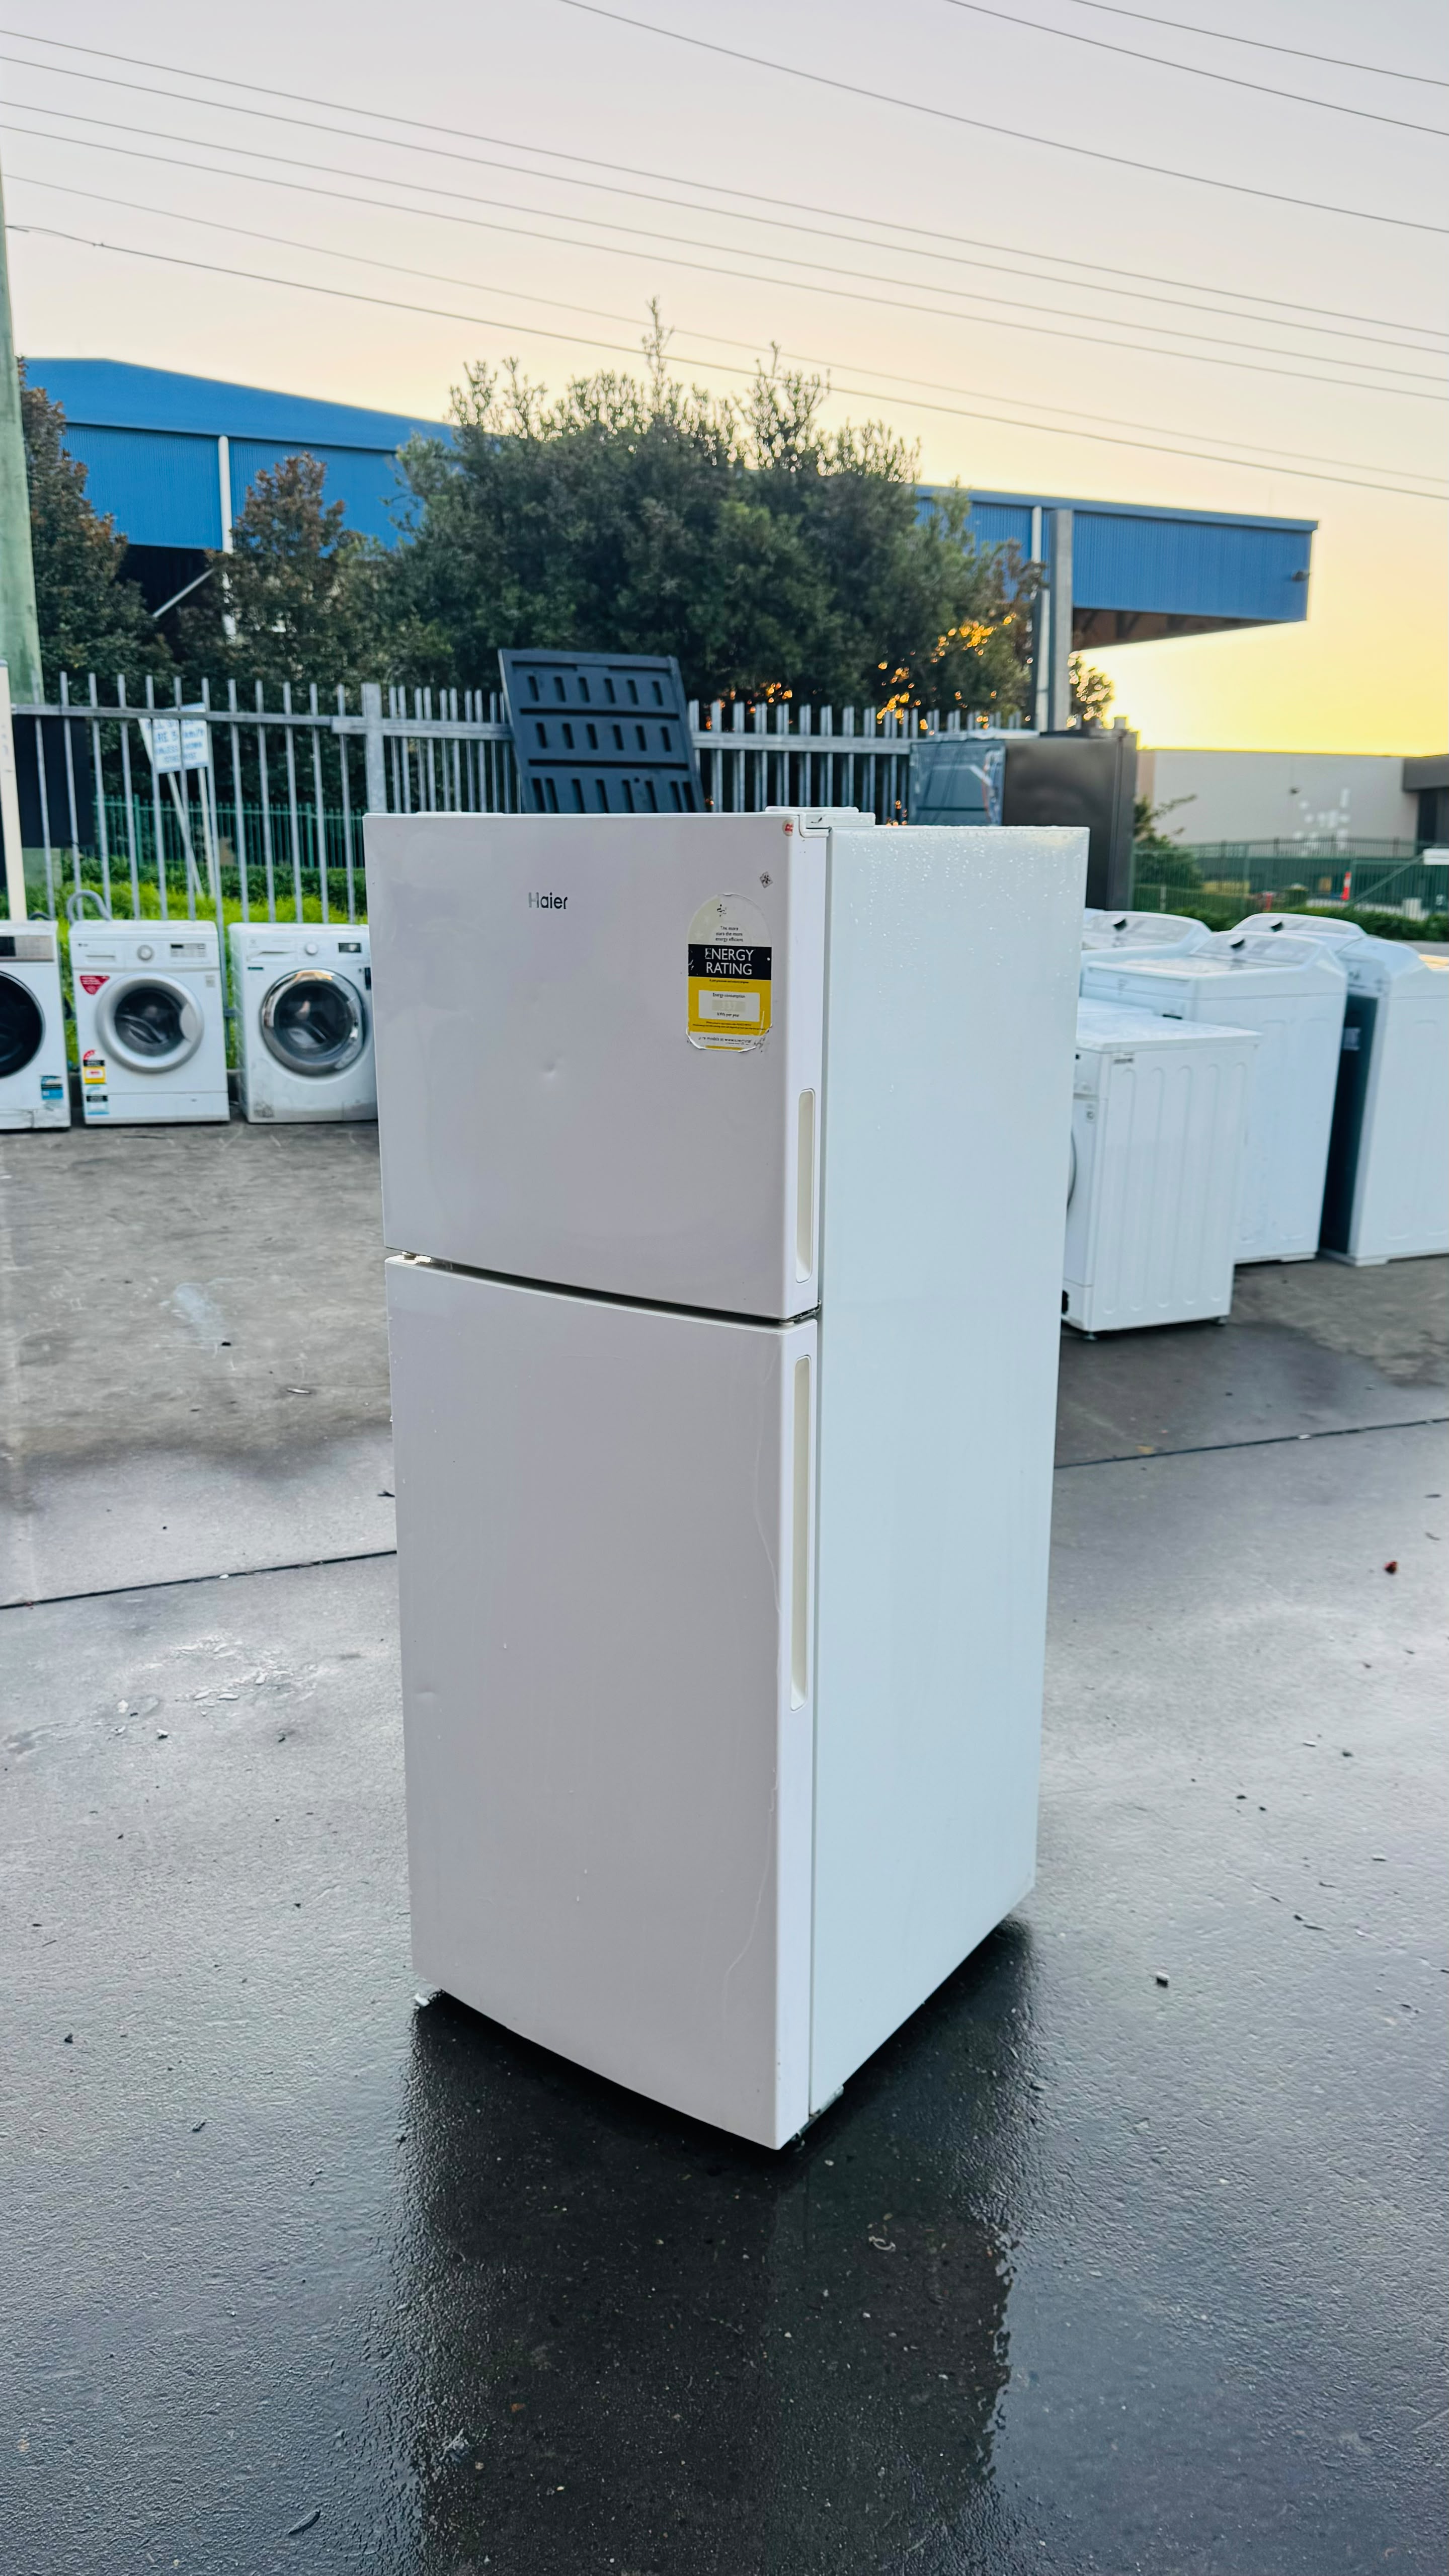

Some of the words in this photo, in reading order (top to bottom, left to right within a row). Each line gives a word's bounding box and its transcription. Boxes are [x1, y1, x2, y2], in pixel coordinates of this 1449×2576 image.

[528, 892, 568, 910] Haier
[705, 948, 754, 961] ENERGY
[706, 962, 753, 975] RATING
